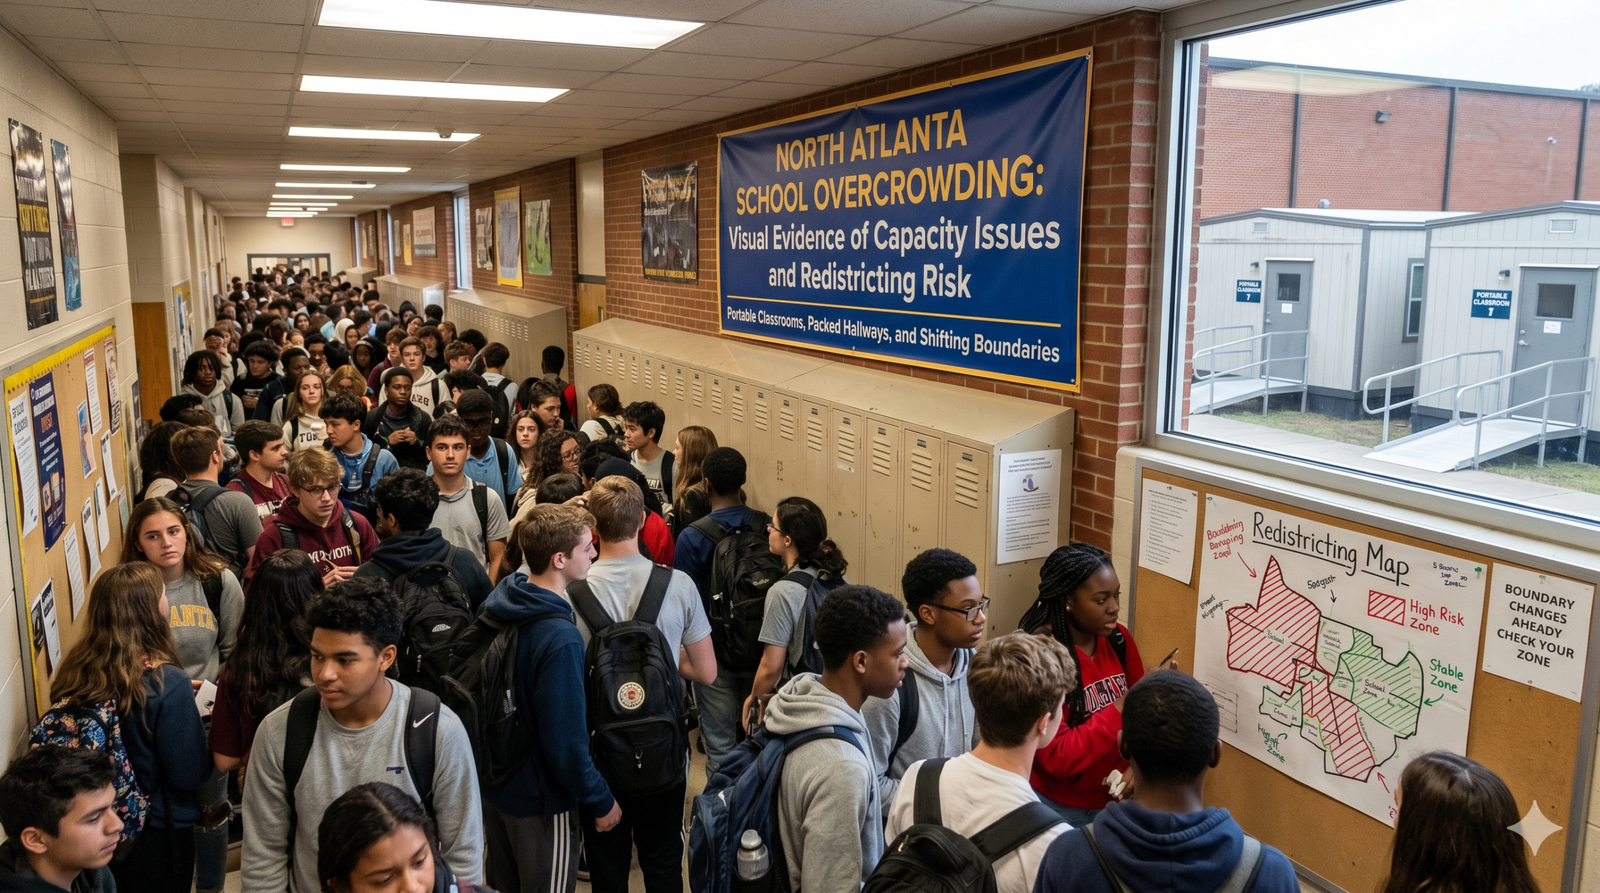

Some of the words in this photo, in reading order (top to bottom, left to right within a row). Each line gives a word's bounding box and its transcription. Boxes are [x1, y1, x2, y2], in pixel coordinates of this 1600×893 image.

[776, 132, 844, 172] NORTH
[850, 108, 967, 161] ATLANTA
[736, 182, 808, 215] SCHOOL
[814, 154, 1045, 210] OVERCROWDING:
[729, 224, 768, 251] Visual
[773, 222, 845, 251] Evidence
[850, 220, 869, 251] of
[873, 215, 968, 259] Capacity
[975, 216, 1061, 250] Issues
[768, 262, 796, 288] and
[801, 262, 916, 303] Redistricting
[922, 263, 972, 299] Risk
[726, 306, 757, 324] Portable
[757, 310, 806, 332] Classrooms,
[808, 315, 841, 335] Packed
[843, 319, 892, 345] Hallways,
[895, 326, 917, 345] and
[920, 327, 970, 356] Shifting
[974, 333, 1061, 364] Boundaries
[1252, 511, 1358, 576] Redistricting
[1366, 541, 1410, 587] Map
[1505, 584, 1575, 610] BOUNDARY
[1410, 599, 1436, 621] High
[1440, 606, 1465, 627] Risk
[1410, 617, 1440, 636] Zone
[1509, 601, 1567, 624] CHANGES
[1511, 617, 1562, 639] AHEADY
[1497, 629, 1536, 648] CHECK
[1539, 640, 1575, 659] YOUR
[1429, 658, 1464, 682] Stable
[1517, 649, 1551, 668] ZONE
[1430, 674, 1459, 694] Zone
